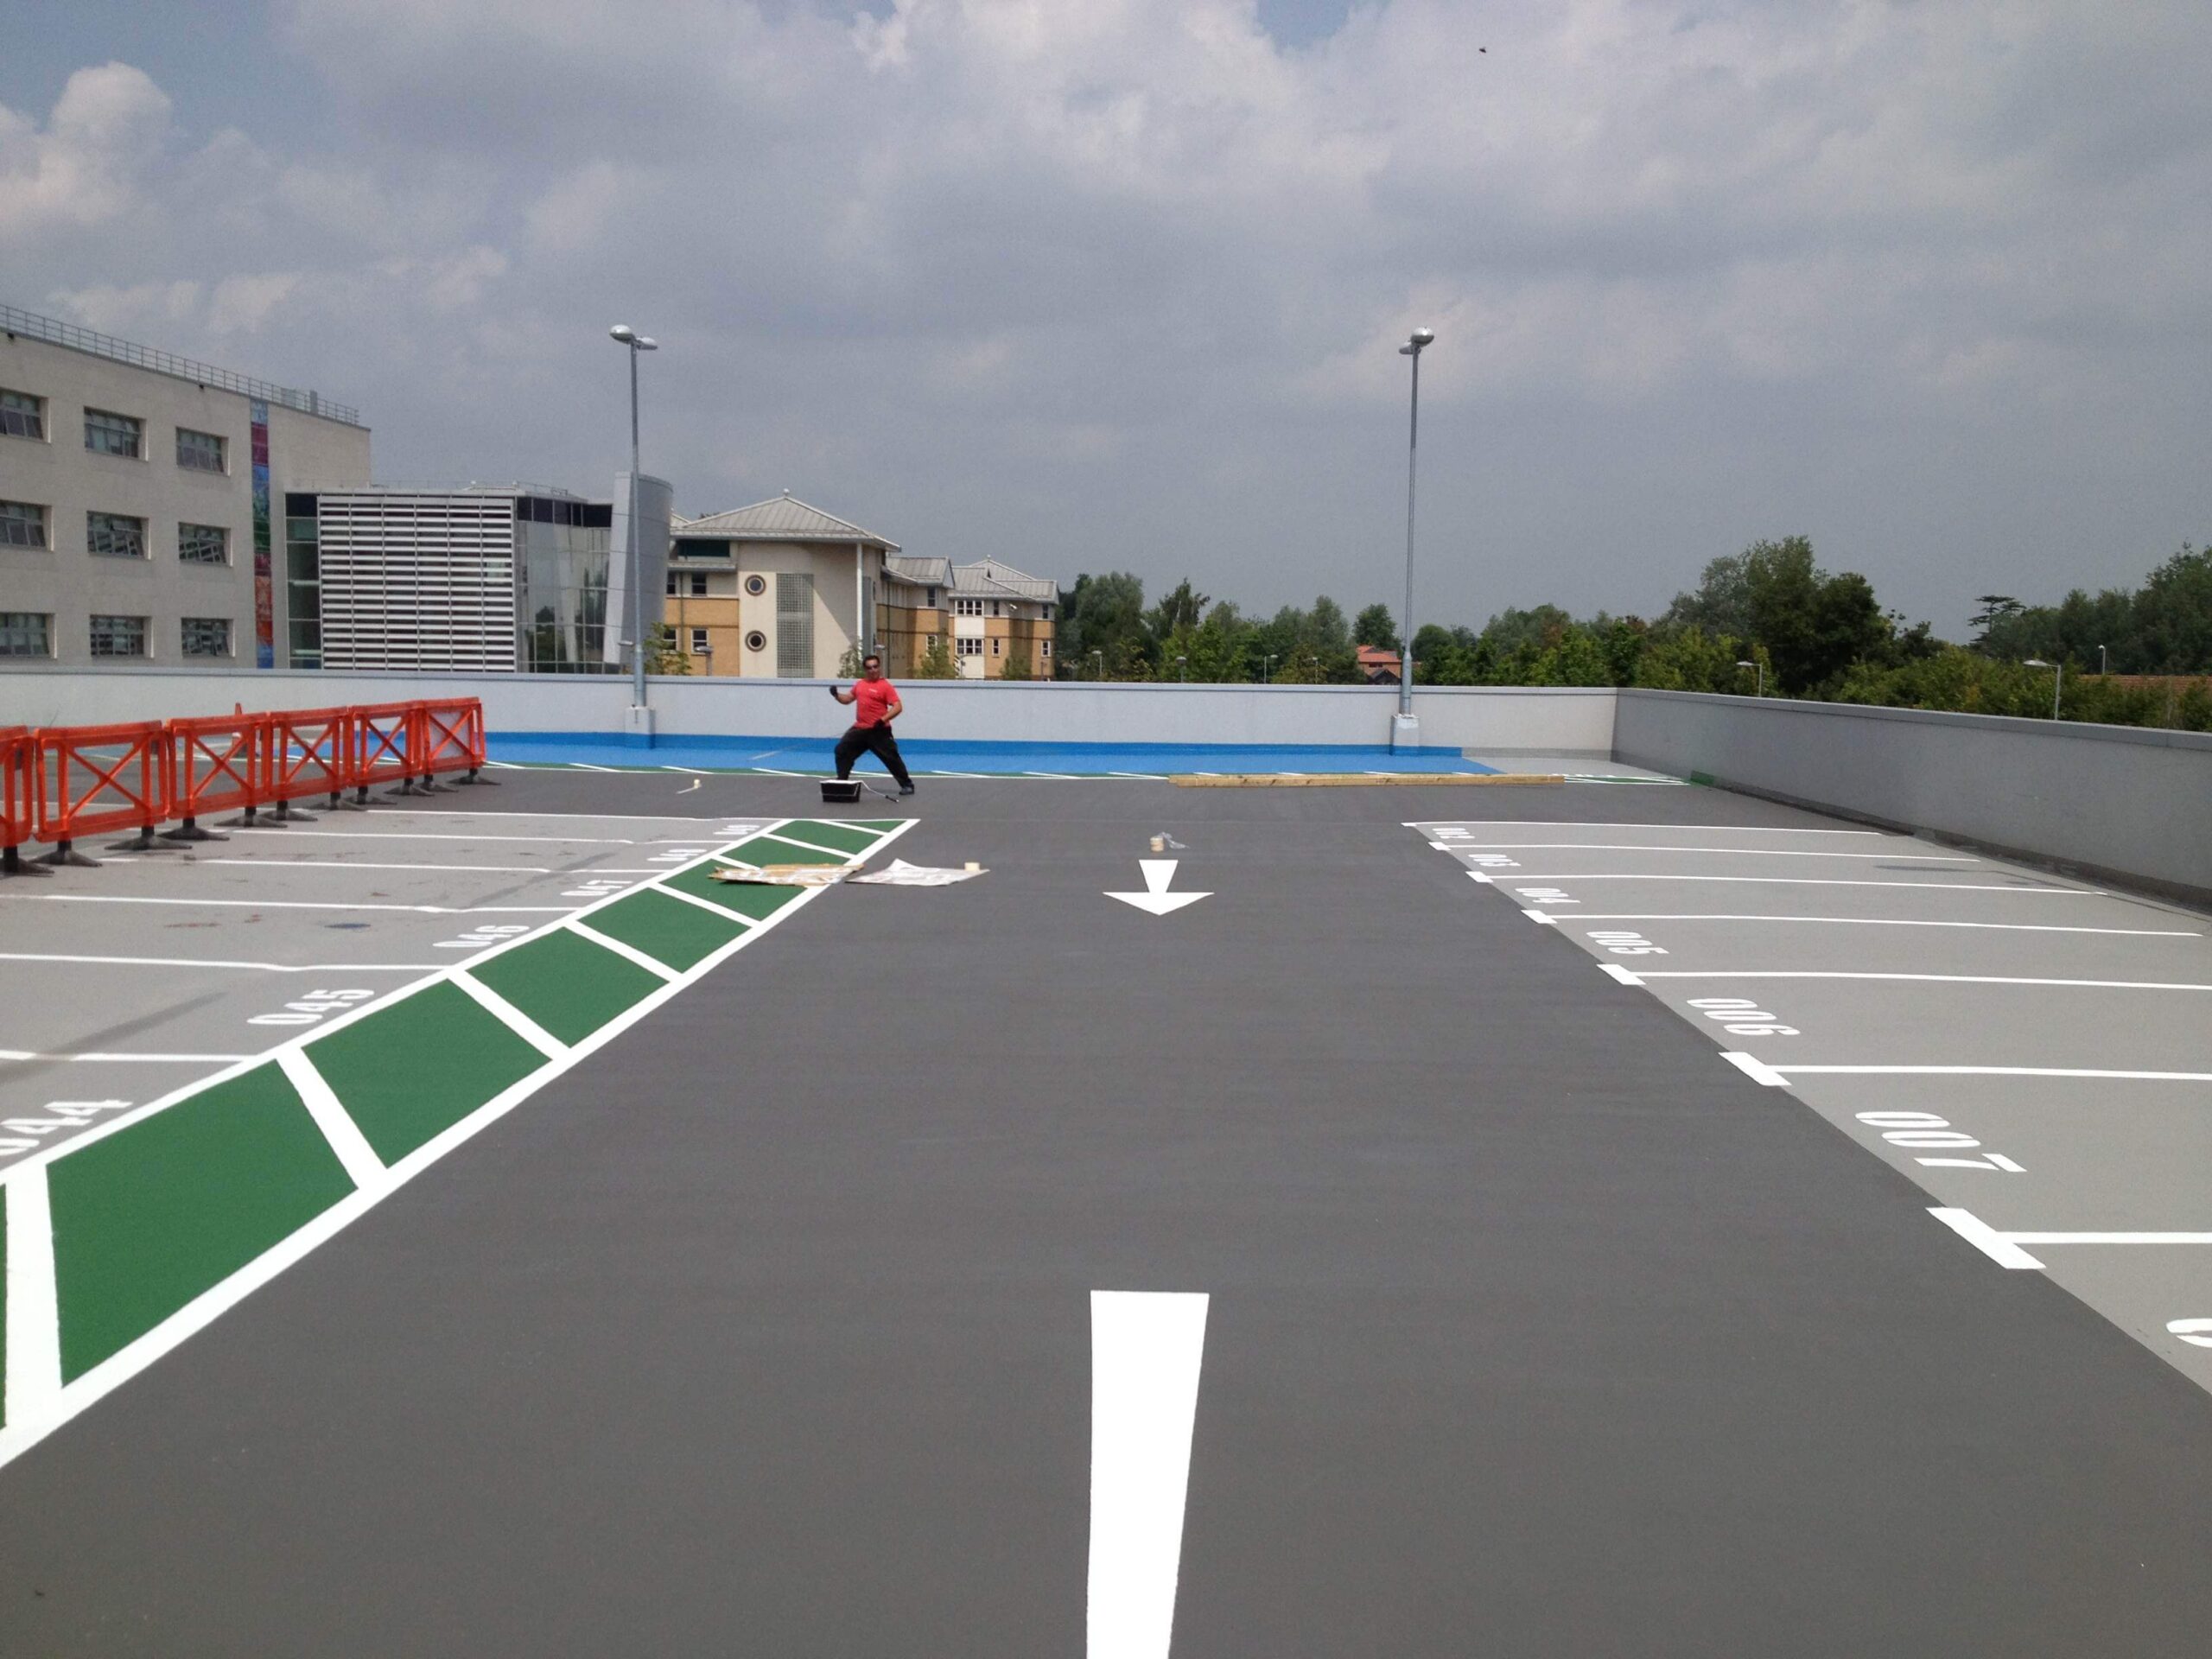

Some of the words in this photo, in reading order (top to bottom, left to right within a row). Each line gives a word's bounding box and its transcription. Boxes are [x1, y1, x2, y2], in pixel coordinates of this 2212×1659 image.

[560, 879, 634, 896] 047
[1515, 887, 1581, 904] 004
[432, 925, 531, 948] 046
[1586, 931, 1669, 955] 005
[246, 988, 375, 1026] 045
[1686, 997, 1801, 1036] 006
[1854, 1110, 2027, 1173] 007
